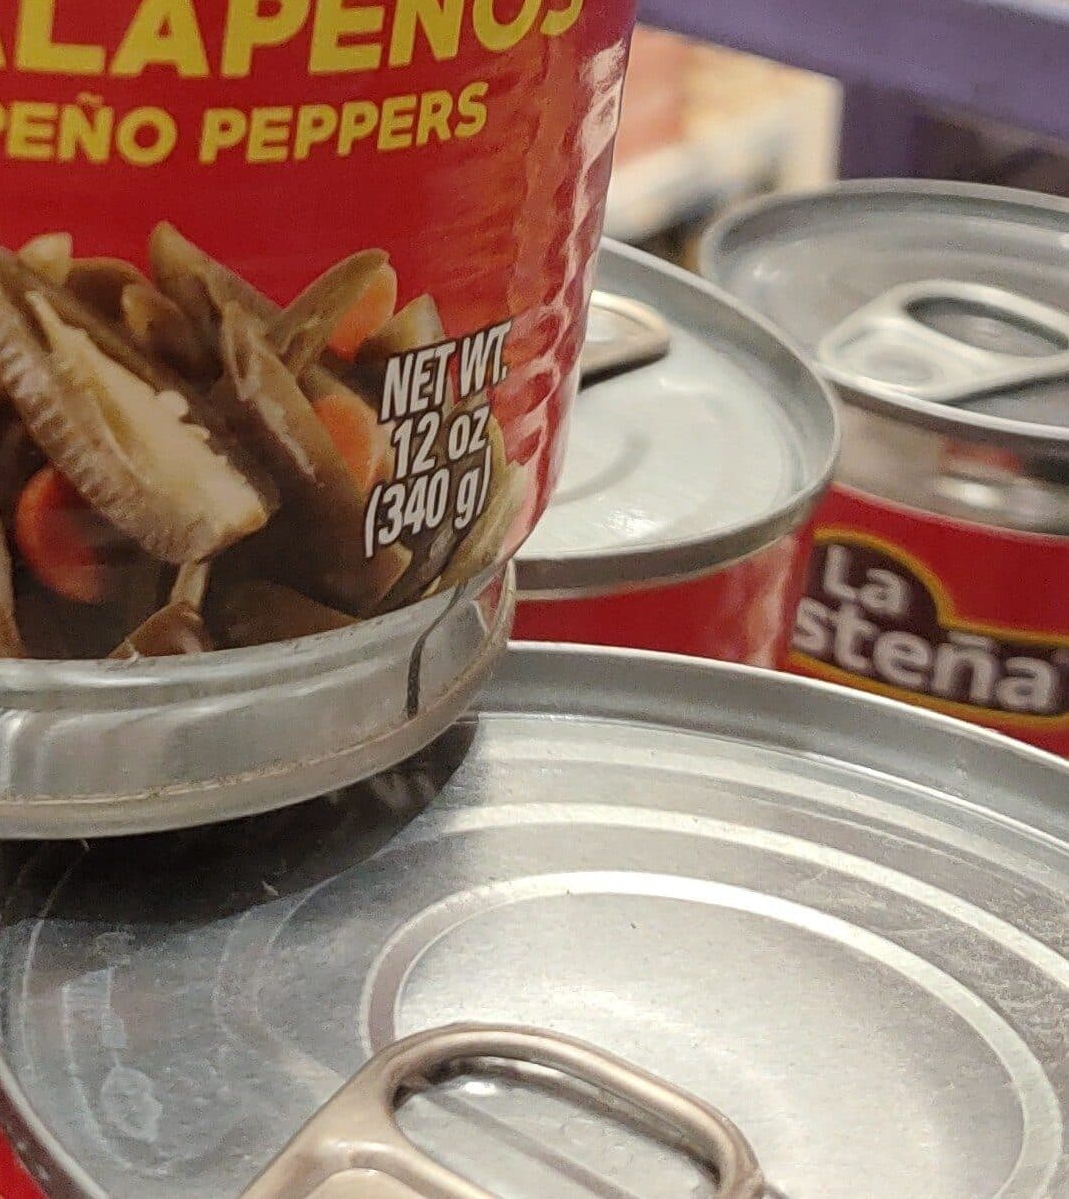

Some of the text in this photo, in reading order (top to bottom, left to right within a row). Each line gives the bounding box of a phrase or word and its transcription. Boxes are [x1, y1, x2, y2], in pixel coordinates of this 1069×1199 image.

[199, 82, 488, 165] PEPPERS
[381, 320, 511, 422] NET WT.
[393, 411, 441, 480] 12
[365, 445, 492, 558] (340 g)
[824, 545, 907, 617] La
